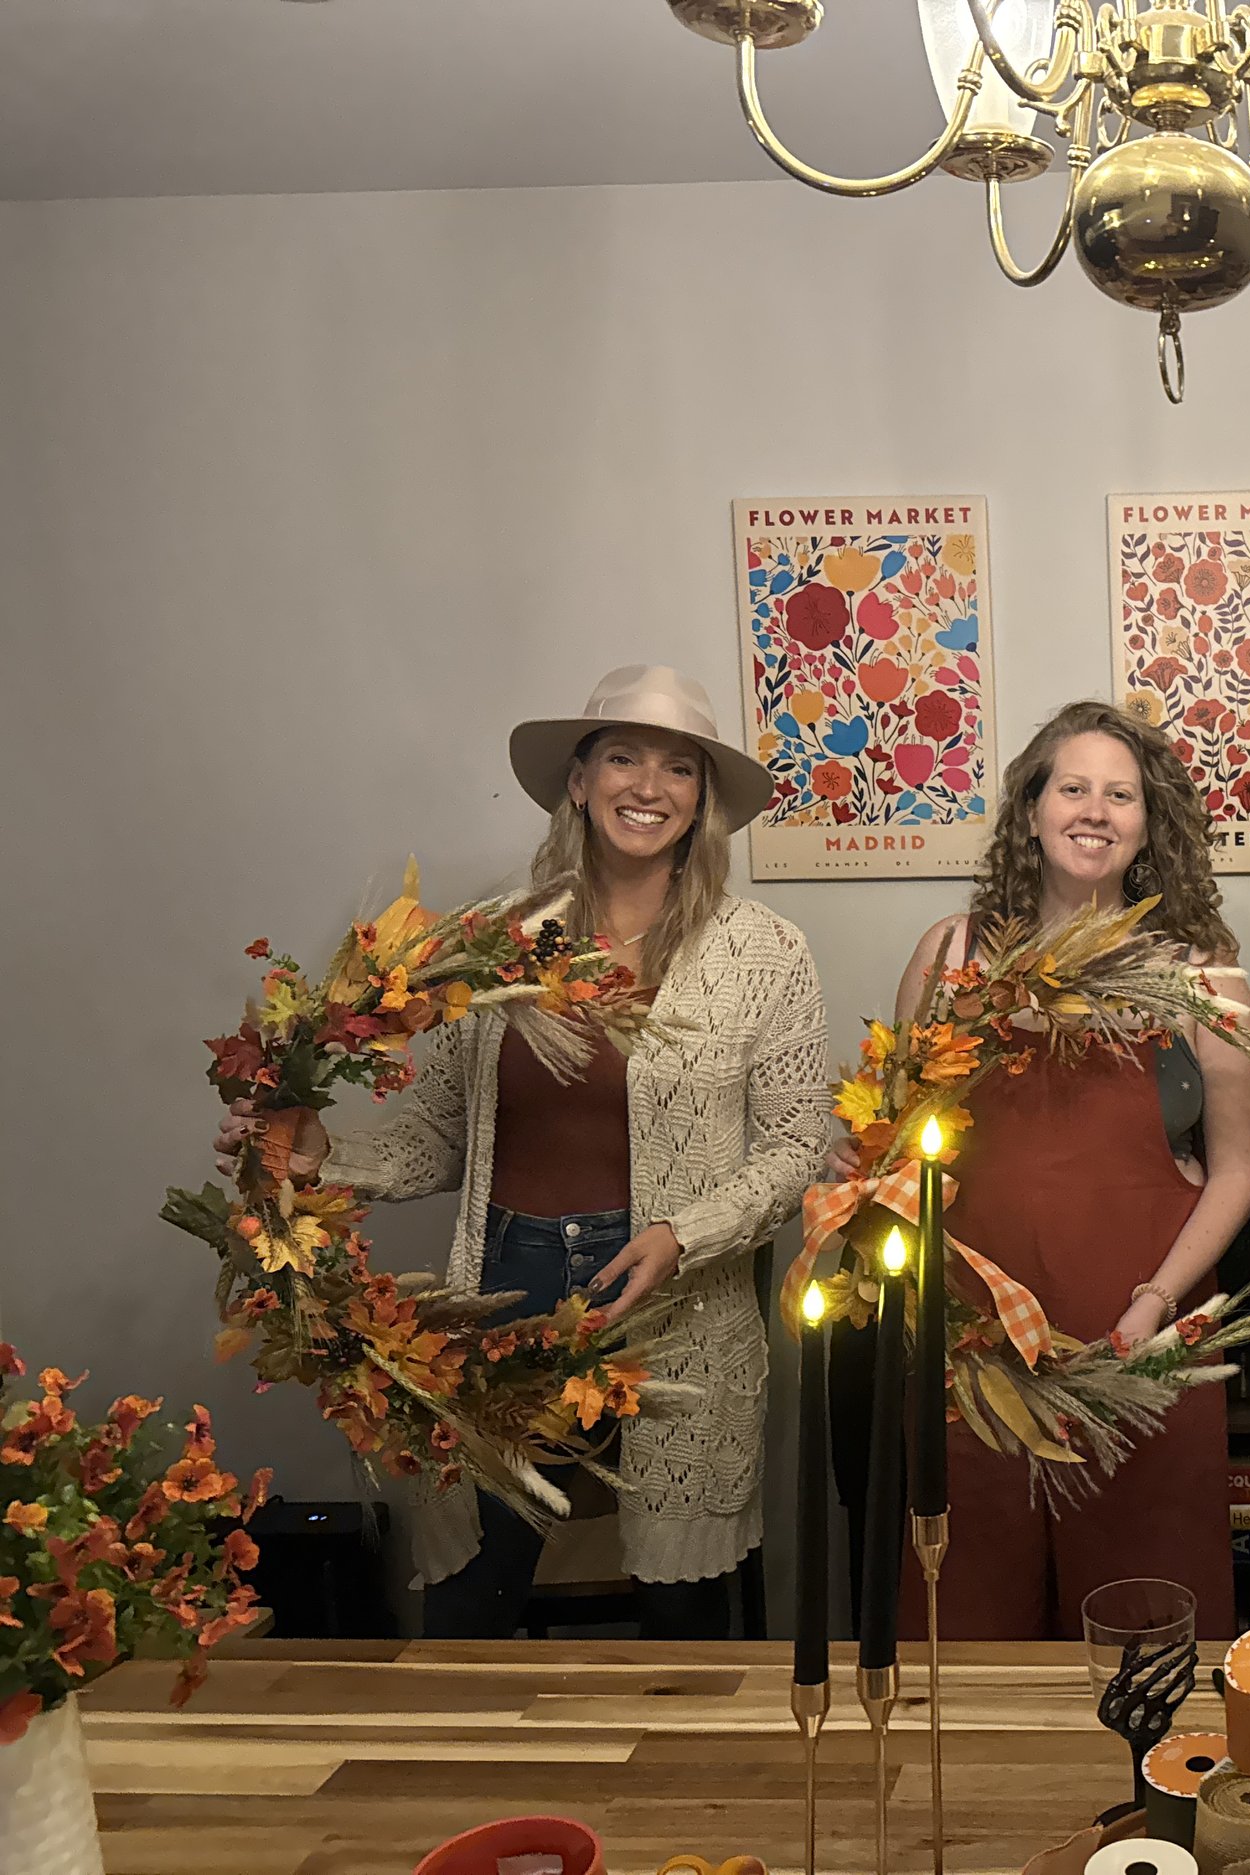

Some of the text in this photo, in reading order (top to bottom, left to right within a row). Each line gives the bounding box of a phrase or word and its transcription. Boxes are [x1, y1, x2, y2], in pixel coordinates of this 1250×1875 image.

[749, 507, 972, 527] FLOWER MARKET
[1123, 504, 1227, 523] FLOWER
[825, 835, 926, 852] MADRID
